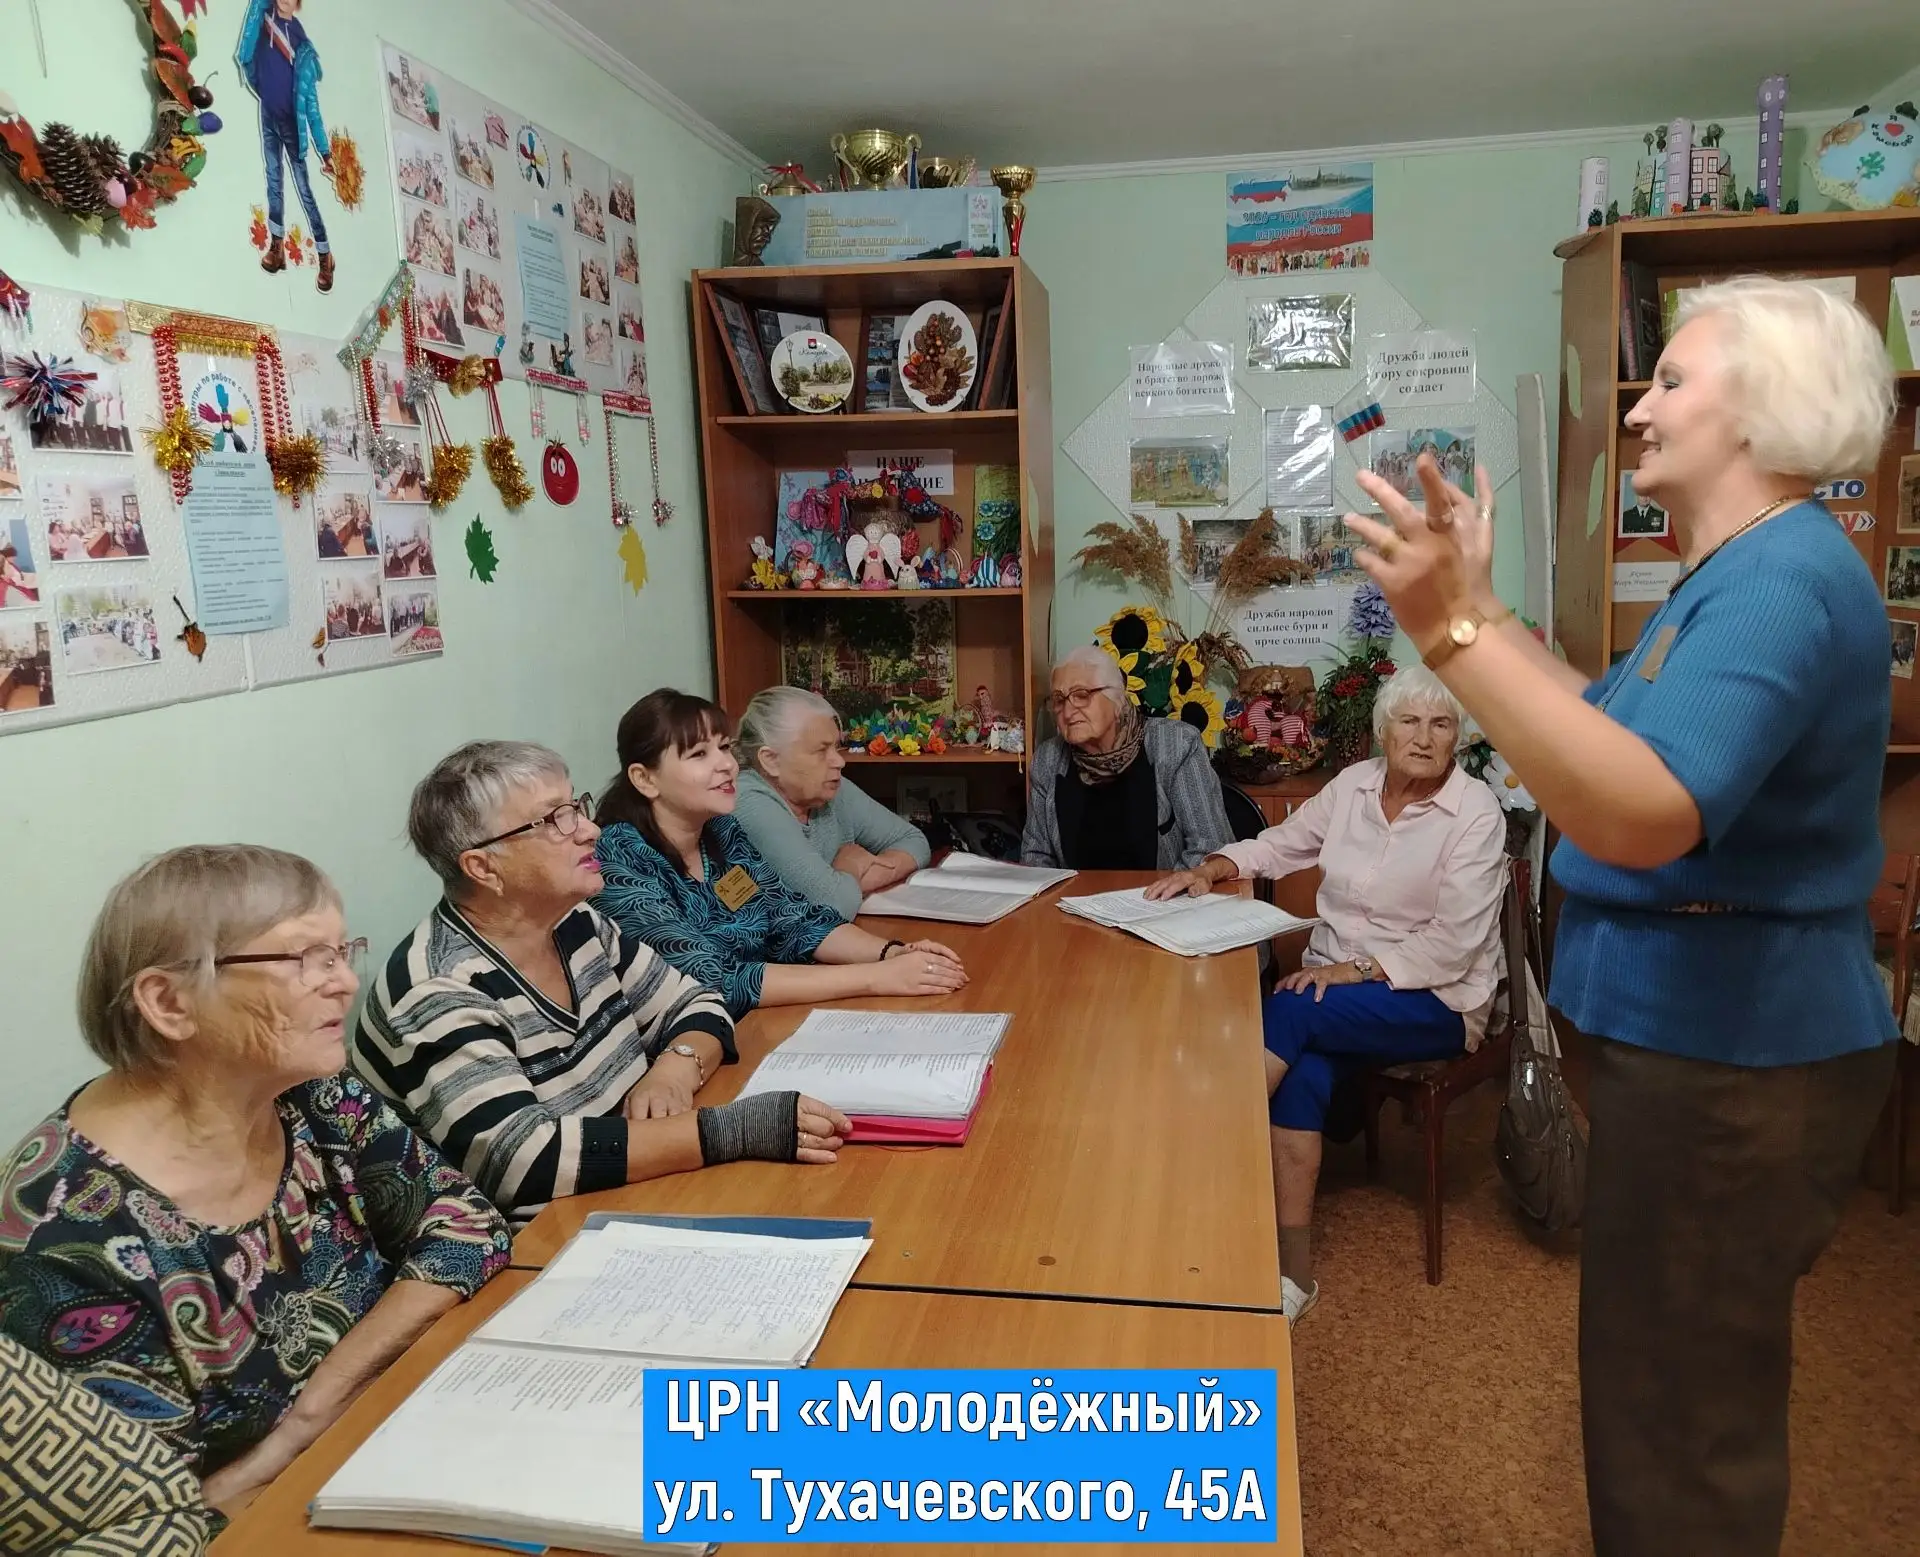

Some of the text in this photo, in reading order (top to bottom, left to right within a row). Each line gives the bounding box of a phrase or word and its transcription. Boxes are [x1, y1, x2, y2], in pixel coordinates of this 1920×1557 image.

[1379, 347, 1469, 365] Дружба людей
[1375, 369, 1402, 381] гору
[1399, 383, 1444, 394] создает
[1244, 608, 1334, 621] Дружба народов
[1247, 621, 1329, 633] сильнее бури и
[1254, 635, 1321, 648] ярче солнца
